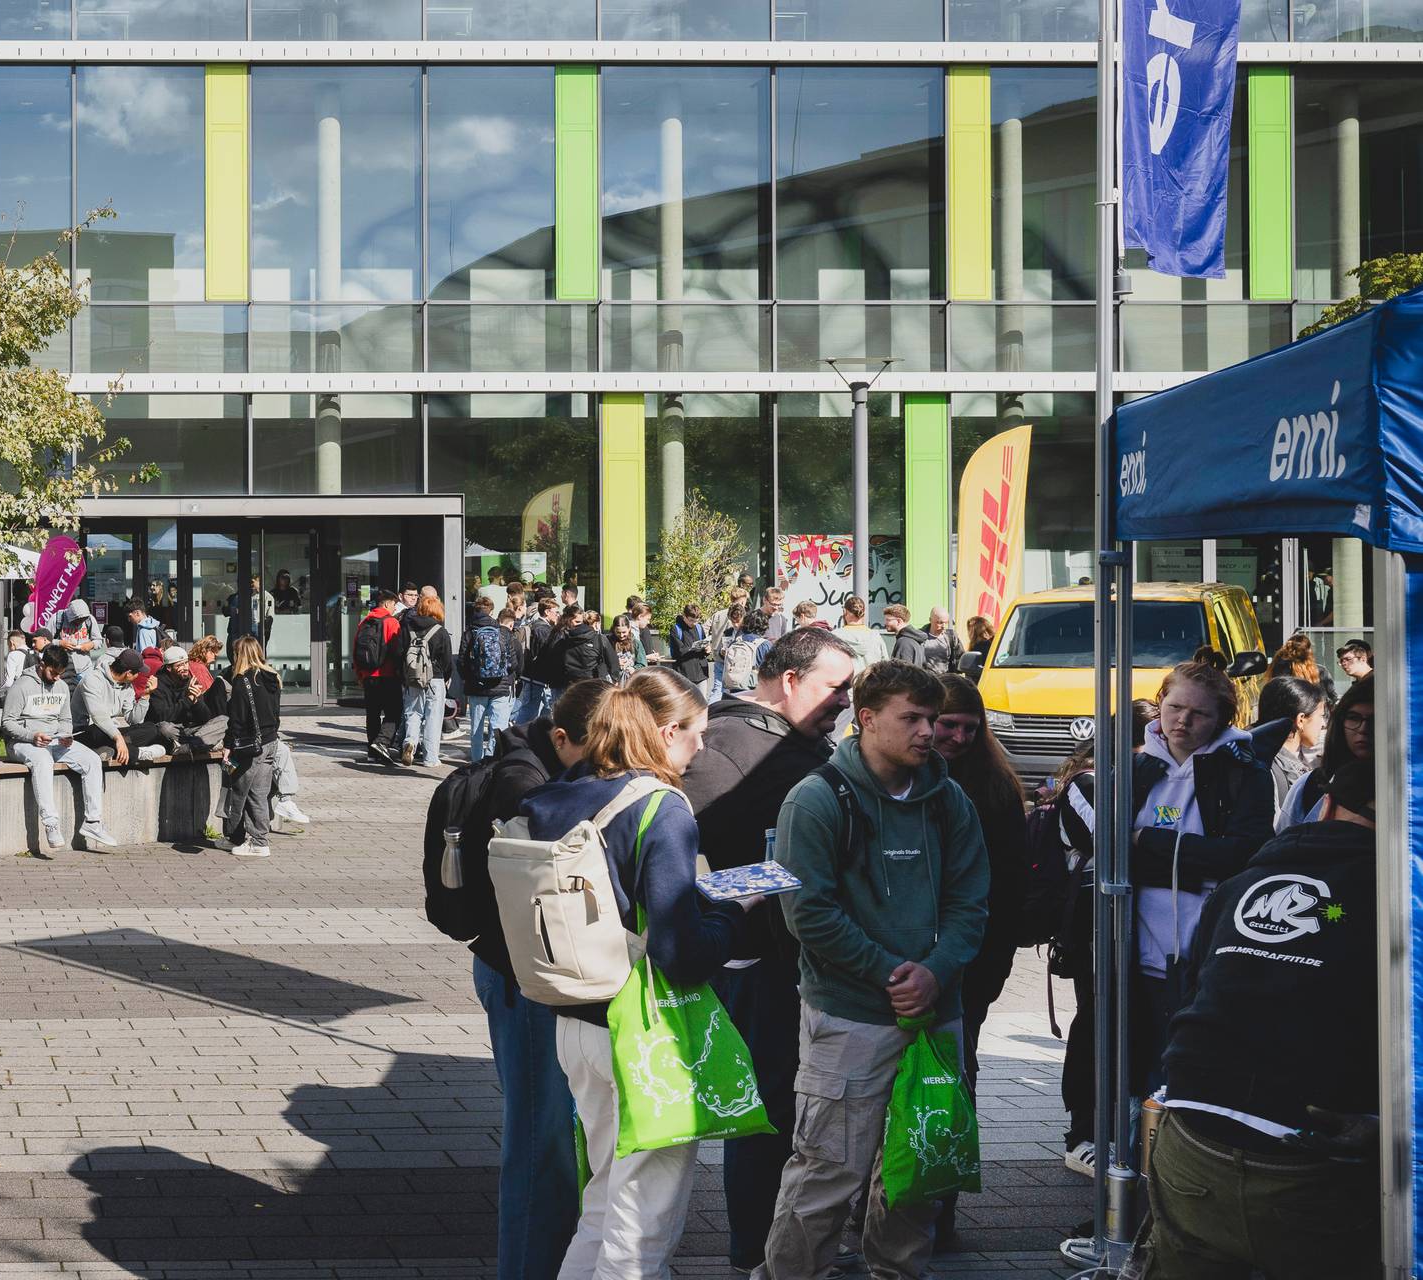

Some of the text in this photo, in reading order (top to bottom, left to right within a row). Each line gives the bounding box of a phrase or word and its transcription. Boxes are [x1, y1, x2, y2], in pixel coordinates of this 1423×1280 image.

[1269, 380, 1347, 482] enni.
[37, 574, 69, 629] CONNECT
[32, 695, 63, 706] NEW YORK
[1248, 920, 1290, 934] Graffiti
